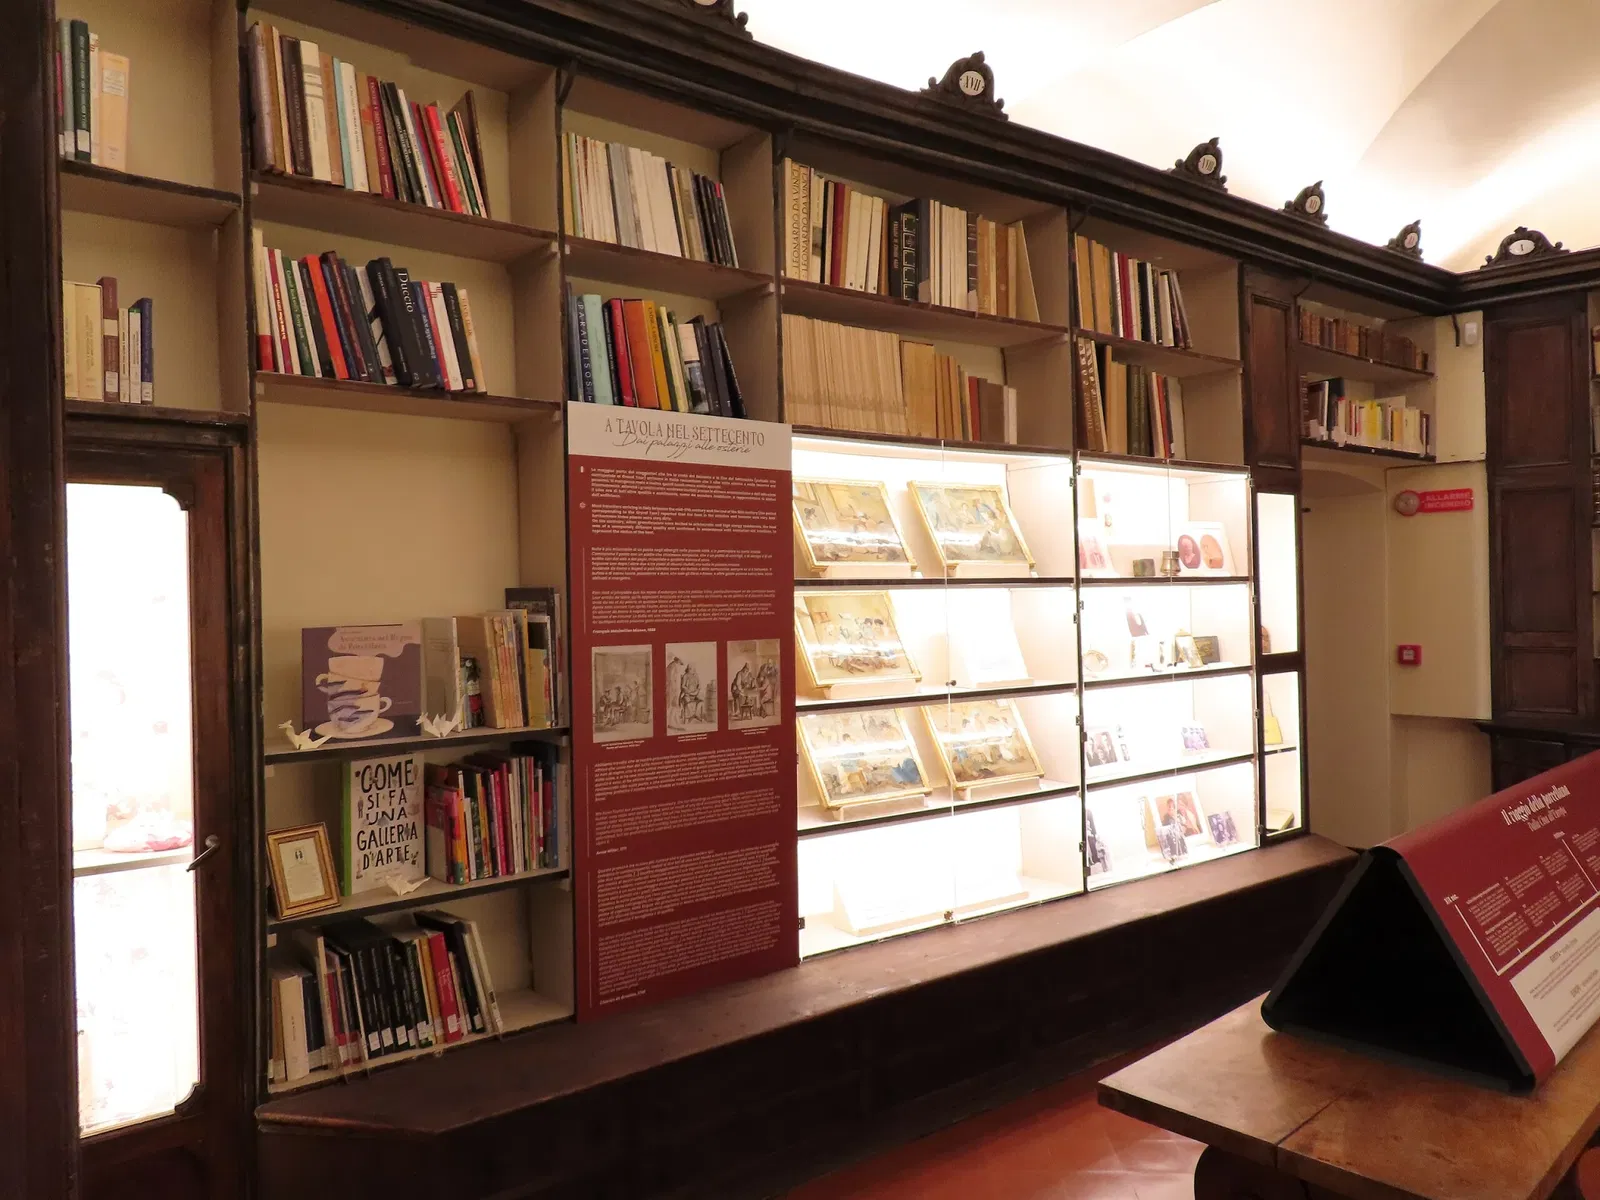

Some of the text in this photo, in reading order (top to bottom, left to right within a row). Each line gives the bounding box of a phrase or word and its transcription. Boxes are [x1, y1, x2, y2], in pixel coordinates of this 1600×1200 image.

[964, 75, 981, 91] XVII
[792, 168, 800, 268] LEONARDO DA VINCI
[800, 172, 808, 271] LEONARDO DA VINCI
[397, 272, 414, 313] Duccio
[577, 304, 592, 387] PARADEISOS
[605, 418, 765, 447] A TAVOLA NEL SETTECENTO
[613, 432, 752, 458] Dai palazzi alle osterie
[1425, 500, 1470, 508] INCENDIO
[1426, 492, 1470, 501] ALLARME
[360, 758, 415, 793] COME
[367, 787, 408, 810] SI FA
[365, 806, 408, 826] UNA
[357, 821, 418, 851] GALLERIA
[363, 843, 411, 870] D'ARTE
